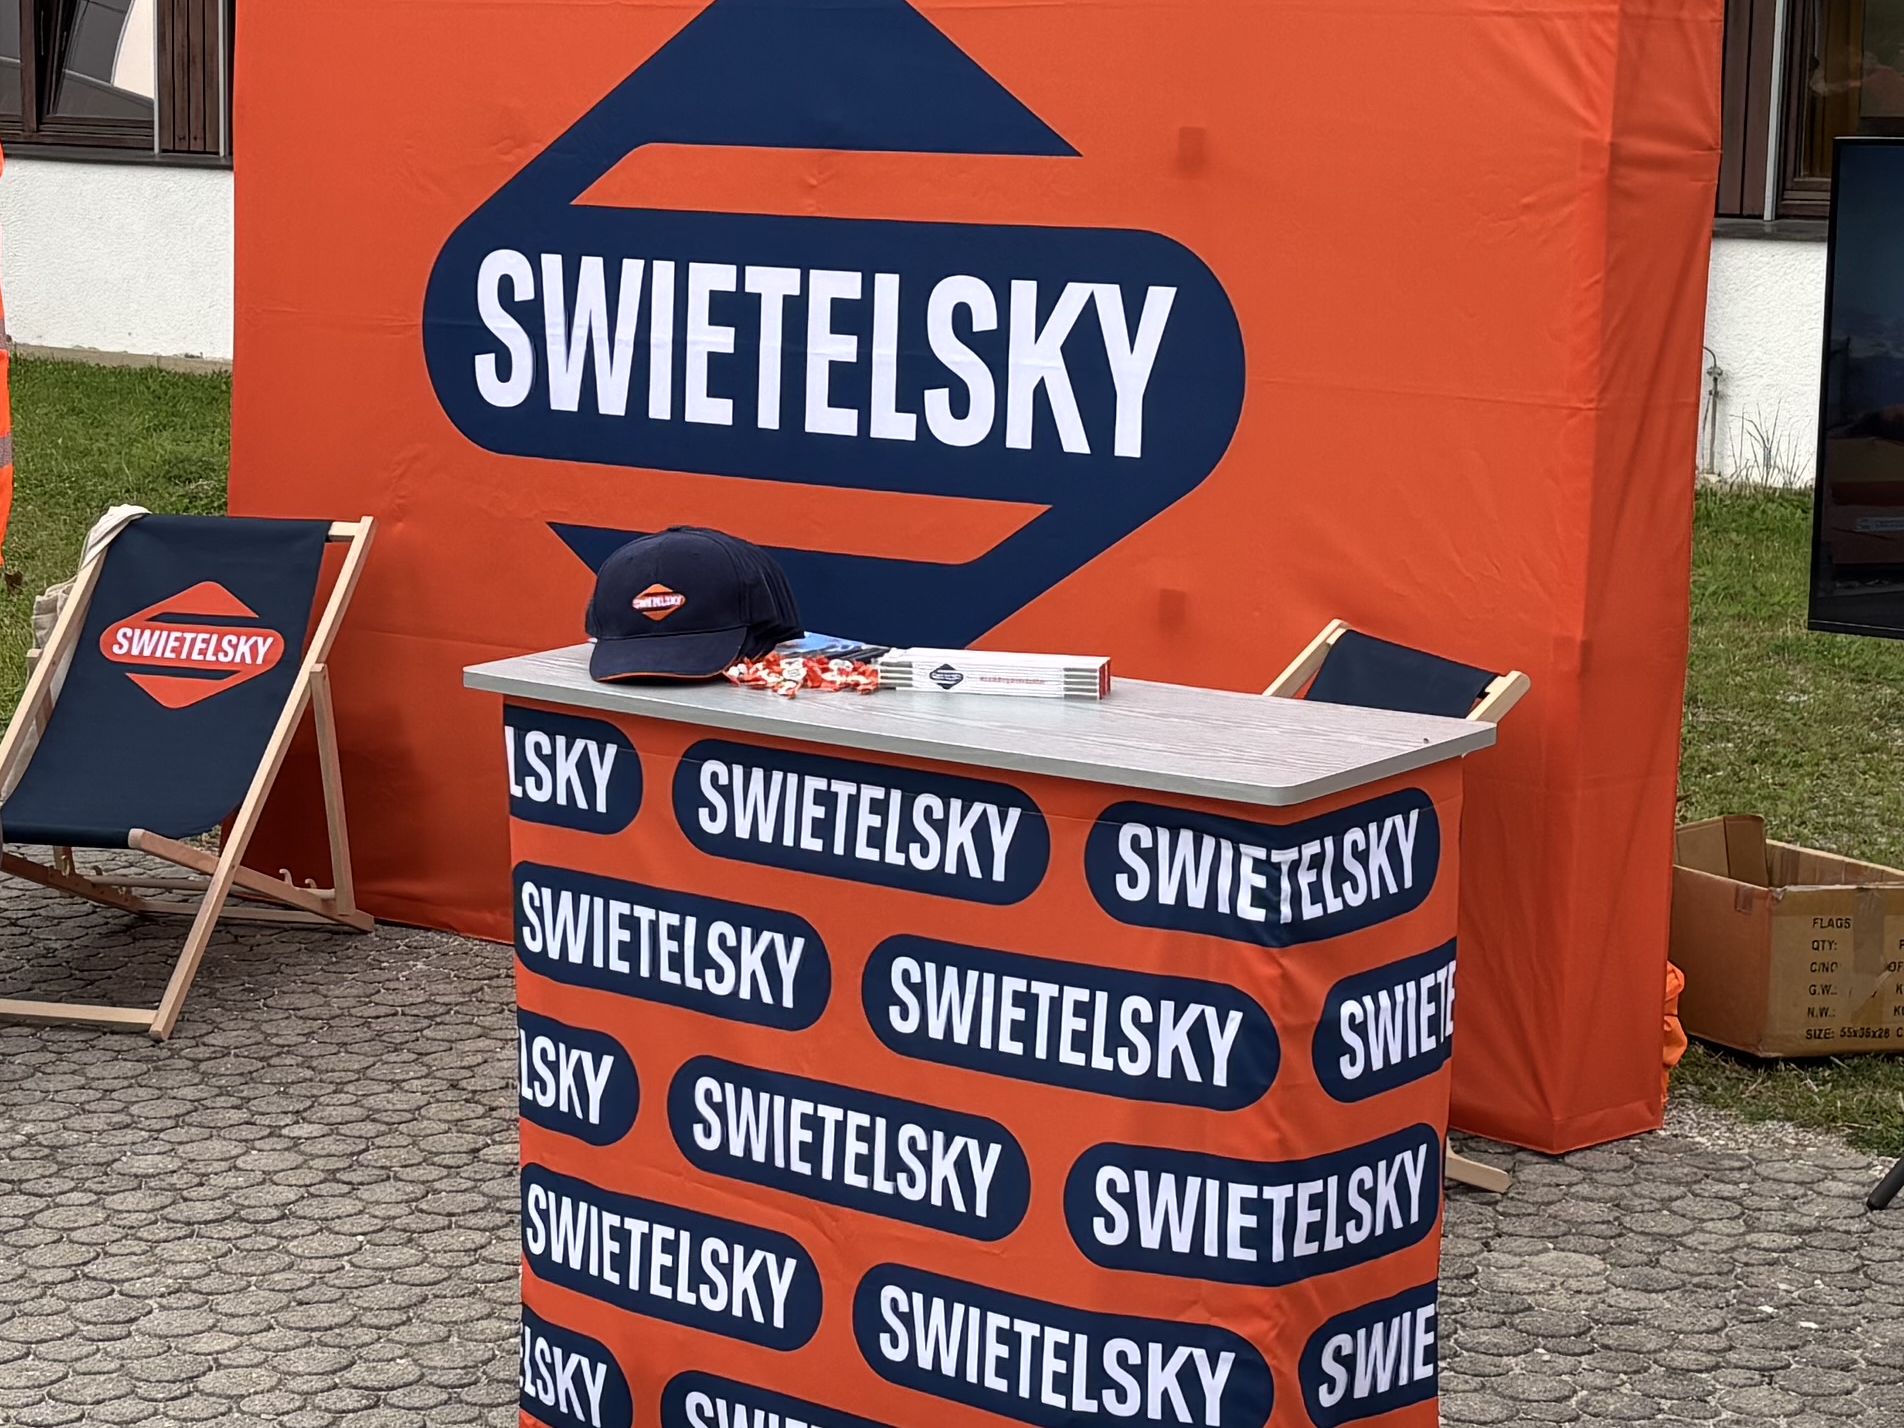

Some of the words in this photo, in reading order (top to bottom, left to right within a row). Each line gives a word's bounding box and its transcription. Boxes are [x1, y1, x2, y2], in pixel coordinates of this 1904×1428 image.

[475, 249, 1177, 457] SWIETELSKY
[113, 628, 273, 664] SWIETELSKY
[505, 726, 617, 812] LSKY
[697, 759, 1021, 882] SWIETELSKY
[1116, 809, 1418, 923] SWIETELSKY
[1812, 917, 1851, 929] FLAGS
[522, 882, 804, 1008] SWIETELSKY
[1811, 939, 1837, 951] QTY:
[889, 957, 1243, 1086] SWIETELSKY
[1805, 1028, 1834, 1040] SIZE:
[693, 1077, 1001, 1217] SWIETELSKY
[1093, 1144, 1426, 1262] SWIETELSKY
[525, 1182, 797, 1330] SWIETELSKY
[520, 1322, 607, 1428] LSKY
[880, 1285, 1235, 1426] SWIETELSKY
[1319, 1304, 1435, 1407] SWIE
